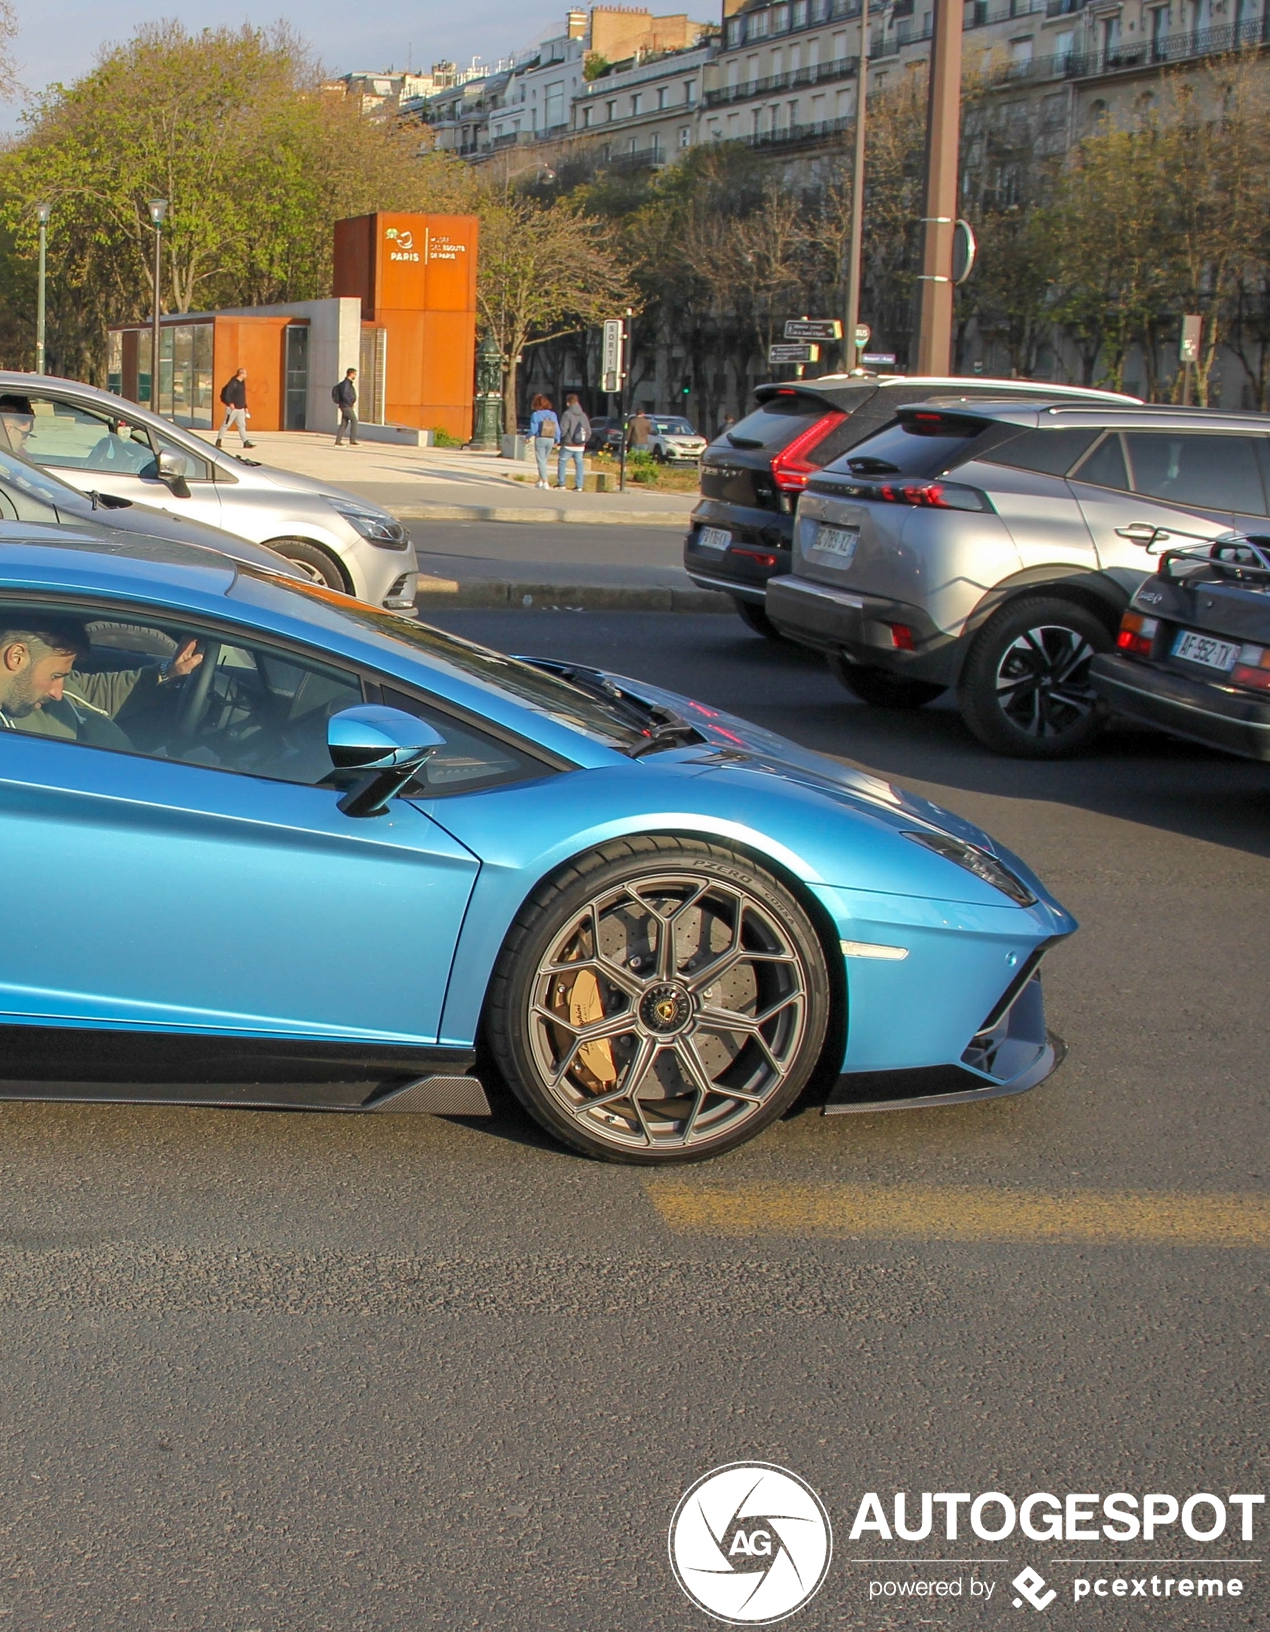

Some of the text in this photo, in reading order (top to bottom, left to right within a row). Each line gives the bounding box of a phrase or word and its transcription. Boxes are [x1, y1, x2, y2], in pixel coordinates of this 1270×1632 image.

[390, 252, 420, 262] PARIS
[855, 329, 868, 337] BUS
[1180, 634, 1232, 668] AF-952-TX
[764, 892, 796, 925] CORSA
